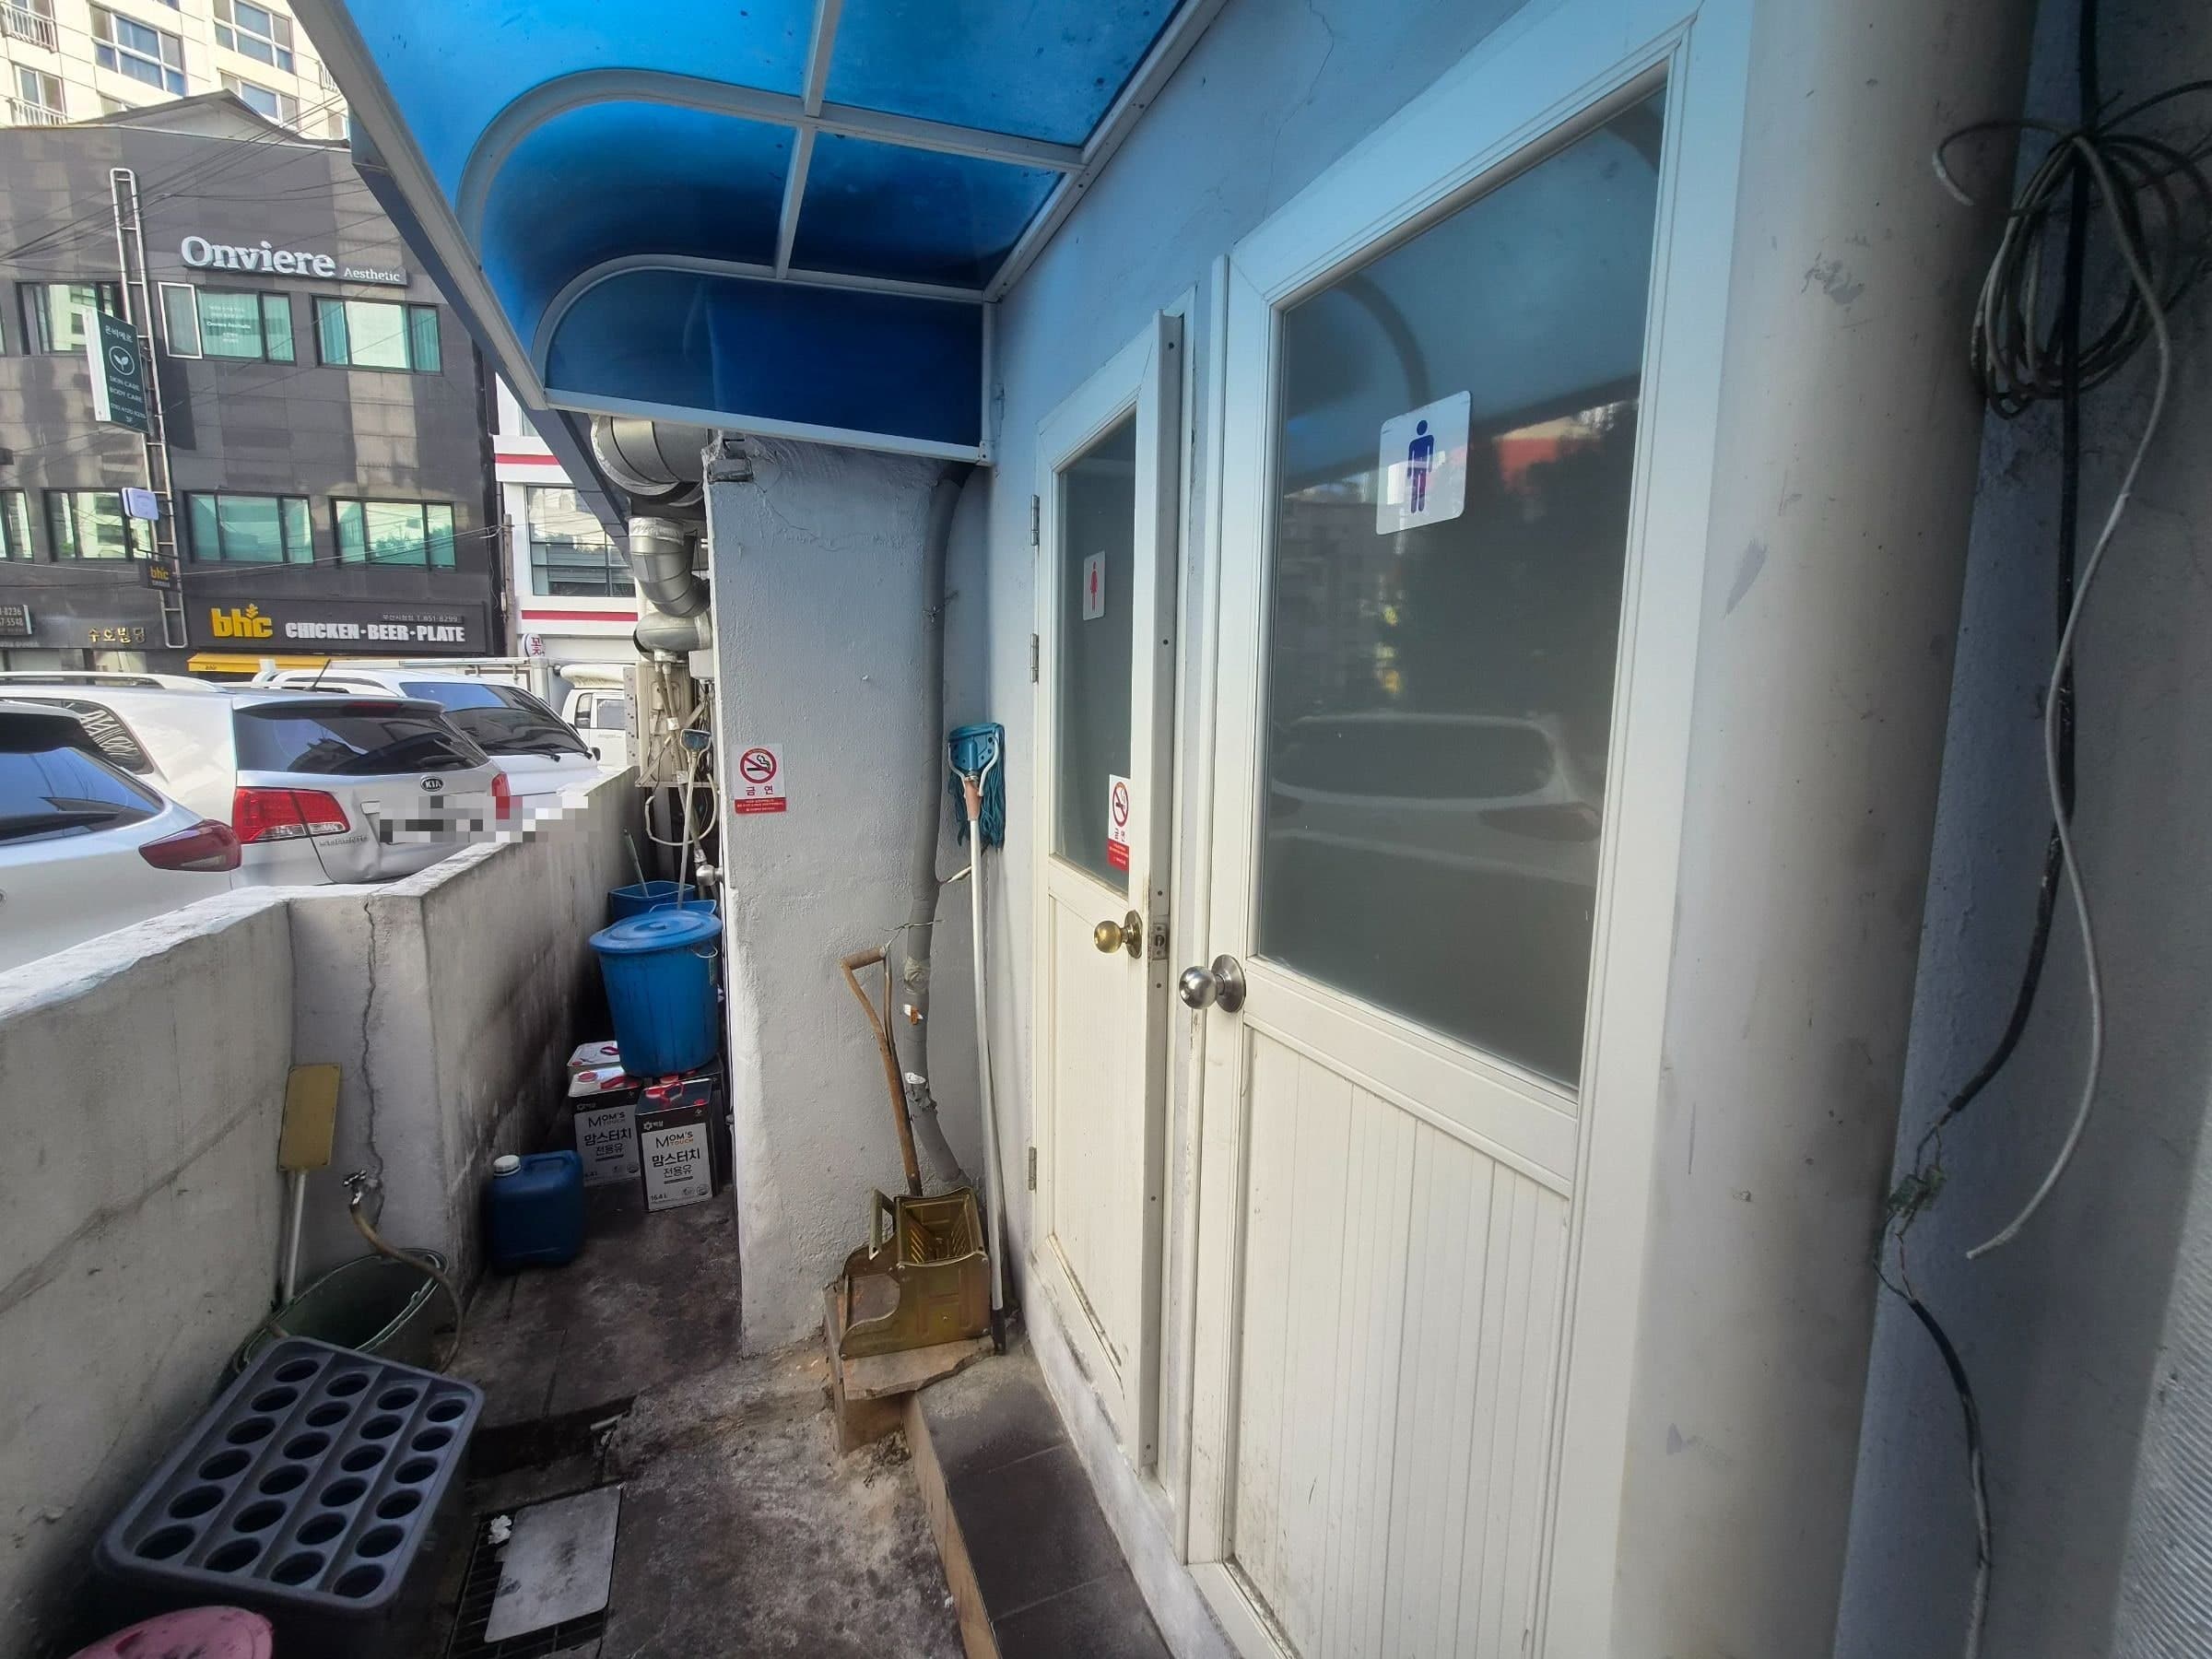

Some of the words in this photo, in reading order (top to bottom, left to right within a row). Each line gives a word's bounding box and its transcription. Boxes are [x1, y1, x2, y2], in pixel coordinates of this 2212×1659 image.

[181, 235, 335, 276] Onviere
[344, 267, 400, 282] Aesthetic
[149, 565, 169, 581] bhc
[210, 606, 273, 639] bhc
[425, 780, 442, 789] KIA
[588, 1112, 626, 1128] MOM'S
[584, 1128, 632, 1147] 맘스터치
[655, 1131, 694, 1148] MOM'S
[670, 1137, 694, 1146] TOUCH
[652, 1148, 700, 1168] 맘스터치
[664, 1165, 693, 1179] 전용유
